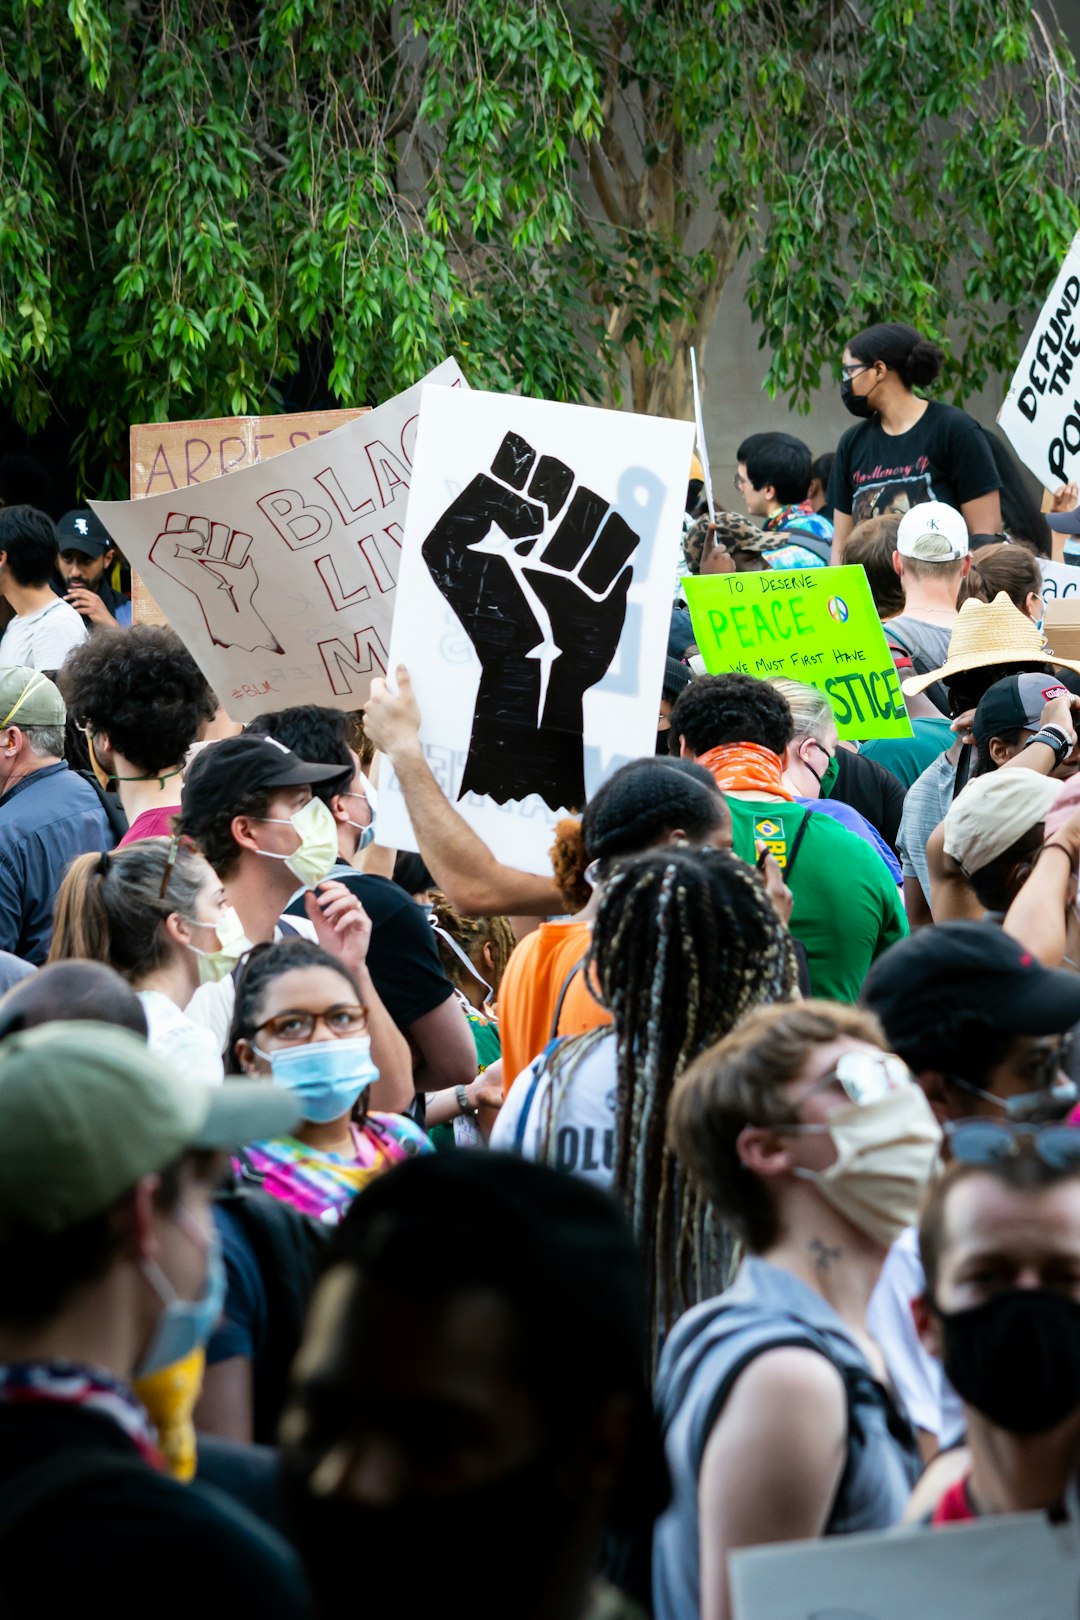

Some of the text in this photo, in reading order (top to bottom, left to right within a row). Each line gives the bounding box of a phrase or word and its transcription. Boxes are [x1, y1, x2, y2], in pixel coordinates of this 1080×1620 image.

[1017, 275, 1080, 423] DEFUND
[1049, 324, 1080, 396] THE
[146, 431, 333, 496] ARR
[1048, 400, 1080, 485] PO
[867, 465, 913, 478] Memory
[315, 522, 405, 612] LI
[725, 574, 817, 594] TO DESERVE
[708, 596, 816, 649] PEACE
[730, 648, 867, 673] WE MUST FIRST HAVE
[231, 681, 280, 699] #BLM
[812, 668, 908, 725] STICE
